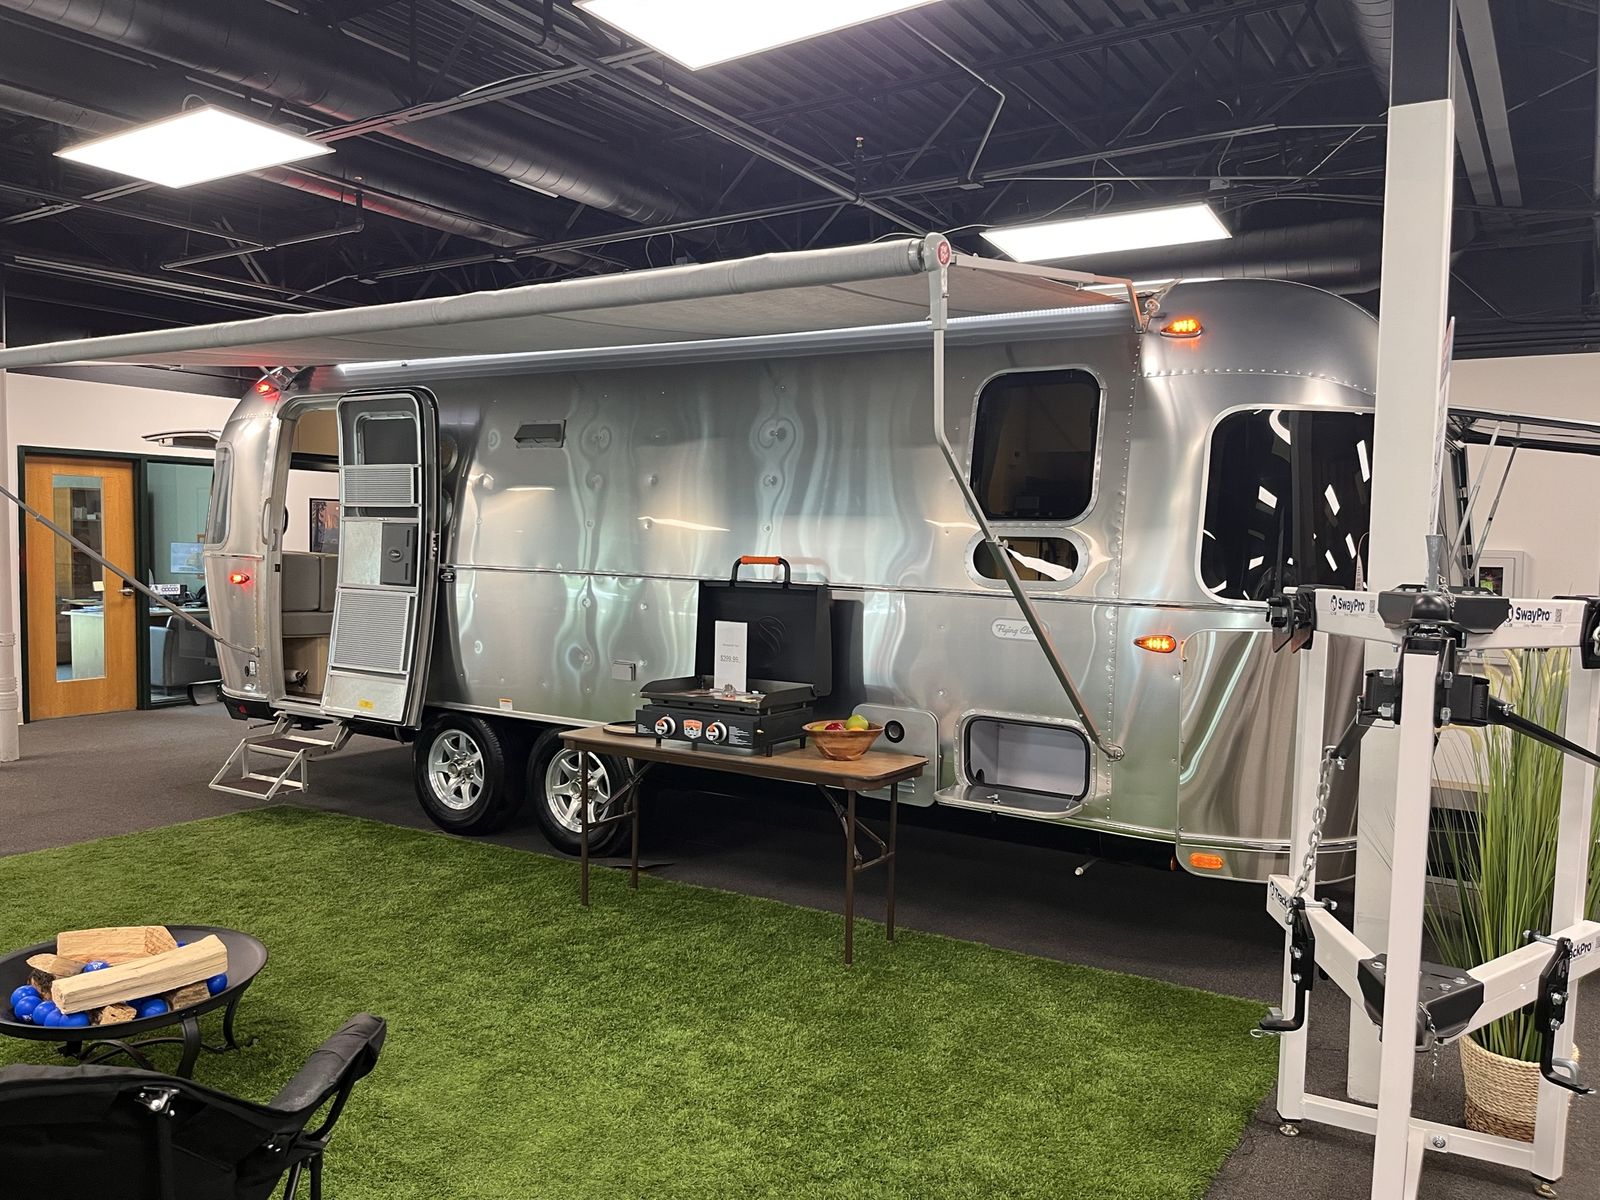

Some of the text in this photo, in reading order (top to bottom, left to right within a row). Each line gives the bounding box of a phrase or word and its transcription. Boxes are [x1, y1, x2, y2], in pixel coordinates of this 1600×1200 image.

[1338, 598, 1365, 613] SwayPro
[1515, 607, 1551, 623] SwayPro
[995, 623, 1019, 637] Flying
